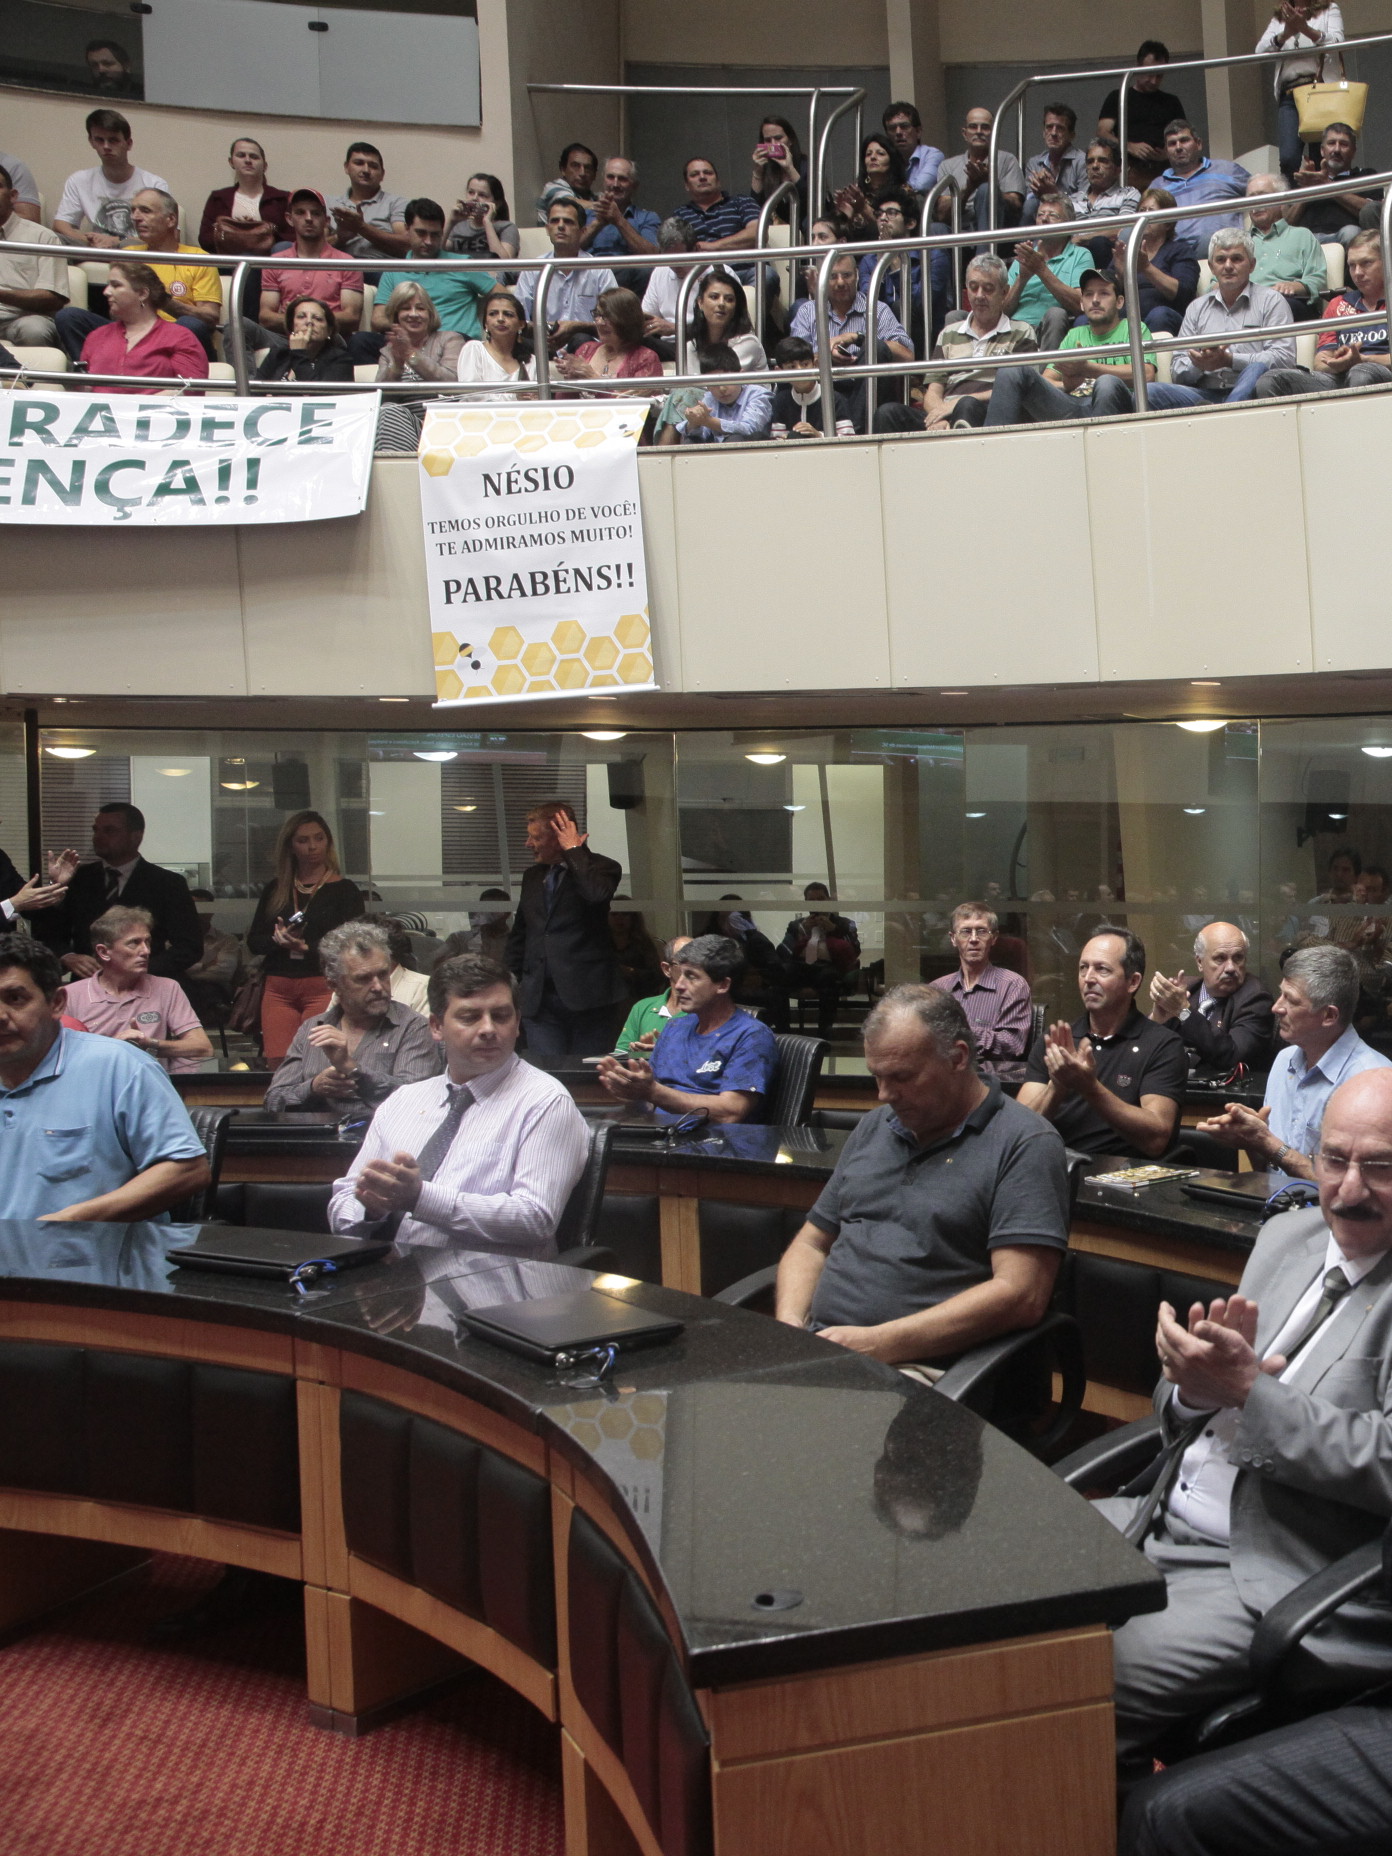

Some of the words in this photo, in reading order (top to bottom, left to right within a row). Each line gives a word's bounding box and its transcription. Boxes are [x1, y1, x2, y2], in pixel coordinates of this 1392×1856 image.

[8, 400, 337, 448] RADECE
[482, 463, 575, 498] NÉSIO
[428, 517, 481, 534] TEMOS
[485, 509, 561, 529] ORGULHO
[565, 507, 587, 521] DE
[590, 500, 638, 518] VOCÊ!
[435, 541, 457, 556] TE
[461, 530, 566, 554] ADMIRAMOS
[570, 525, 633, 544] MUITO!
[443, 561, 635, 605] PARABÉNS!!
